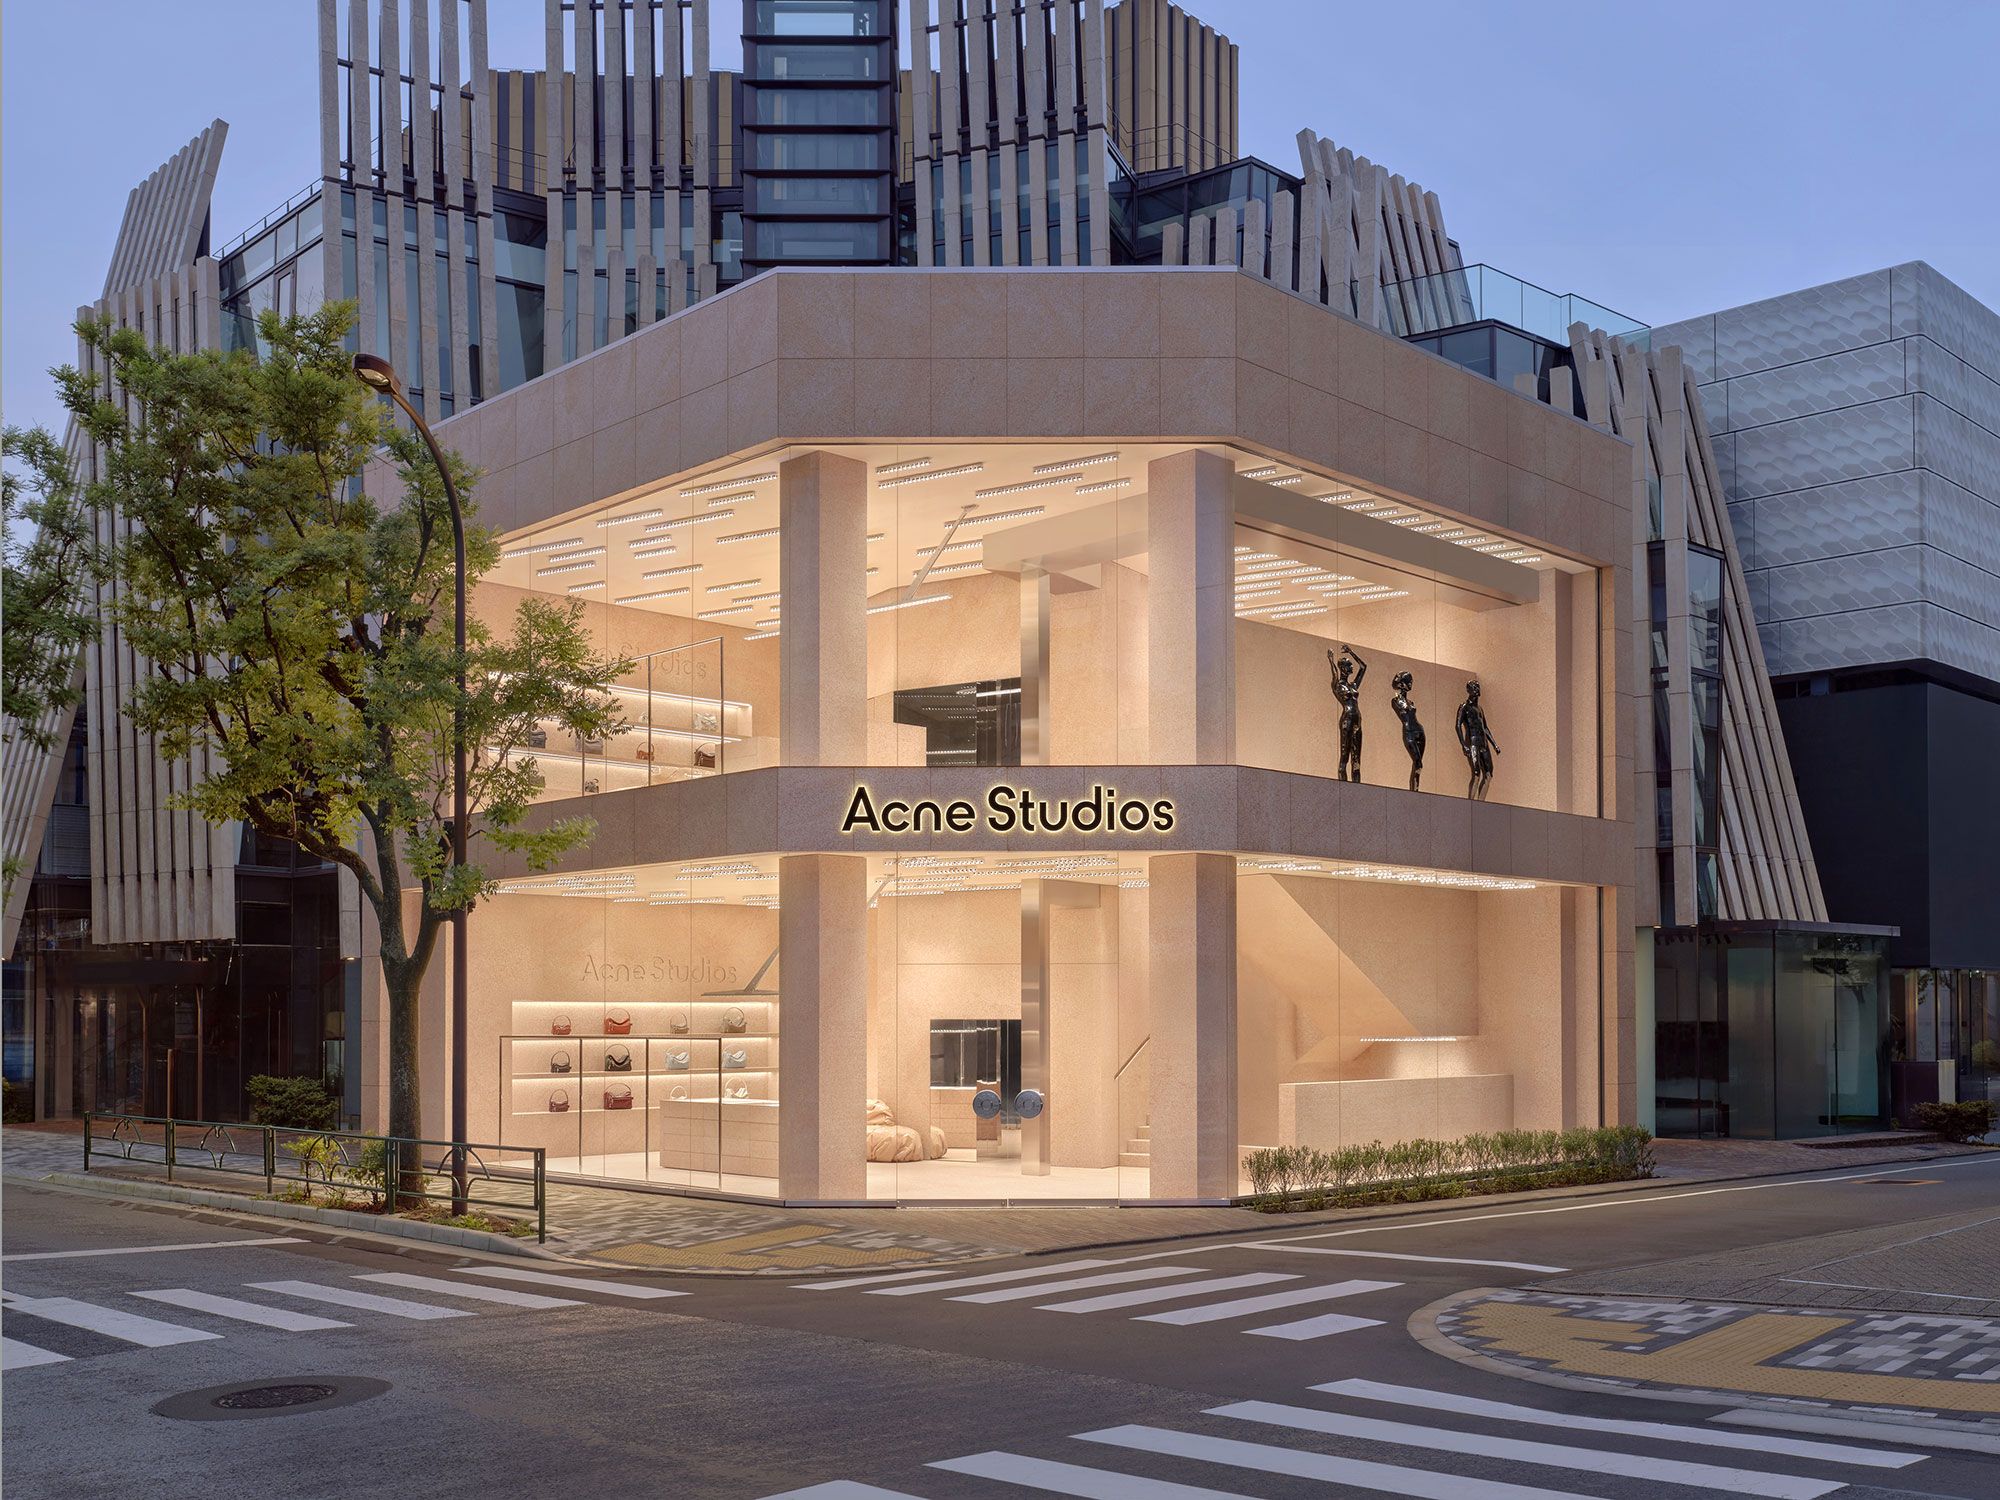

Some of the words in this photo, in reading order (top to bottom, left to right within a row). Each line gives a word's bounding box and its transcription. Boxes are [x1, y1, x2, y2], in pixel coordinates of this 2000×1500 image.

[841, 785, 976, 832] Acne
[987, 785, 1175, 832] Studios
[581, 954, 646, 982] Acne
[650, 955, 738, 984] Studios
